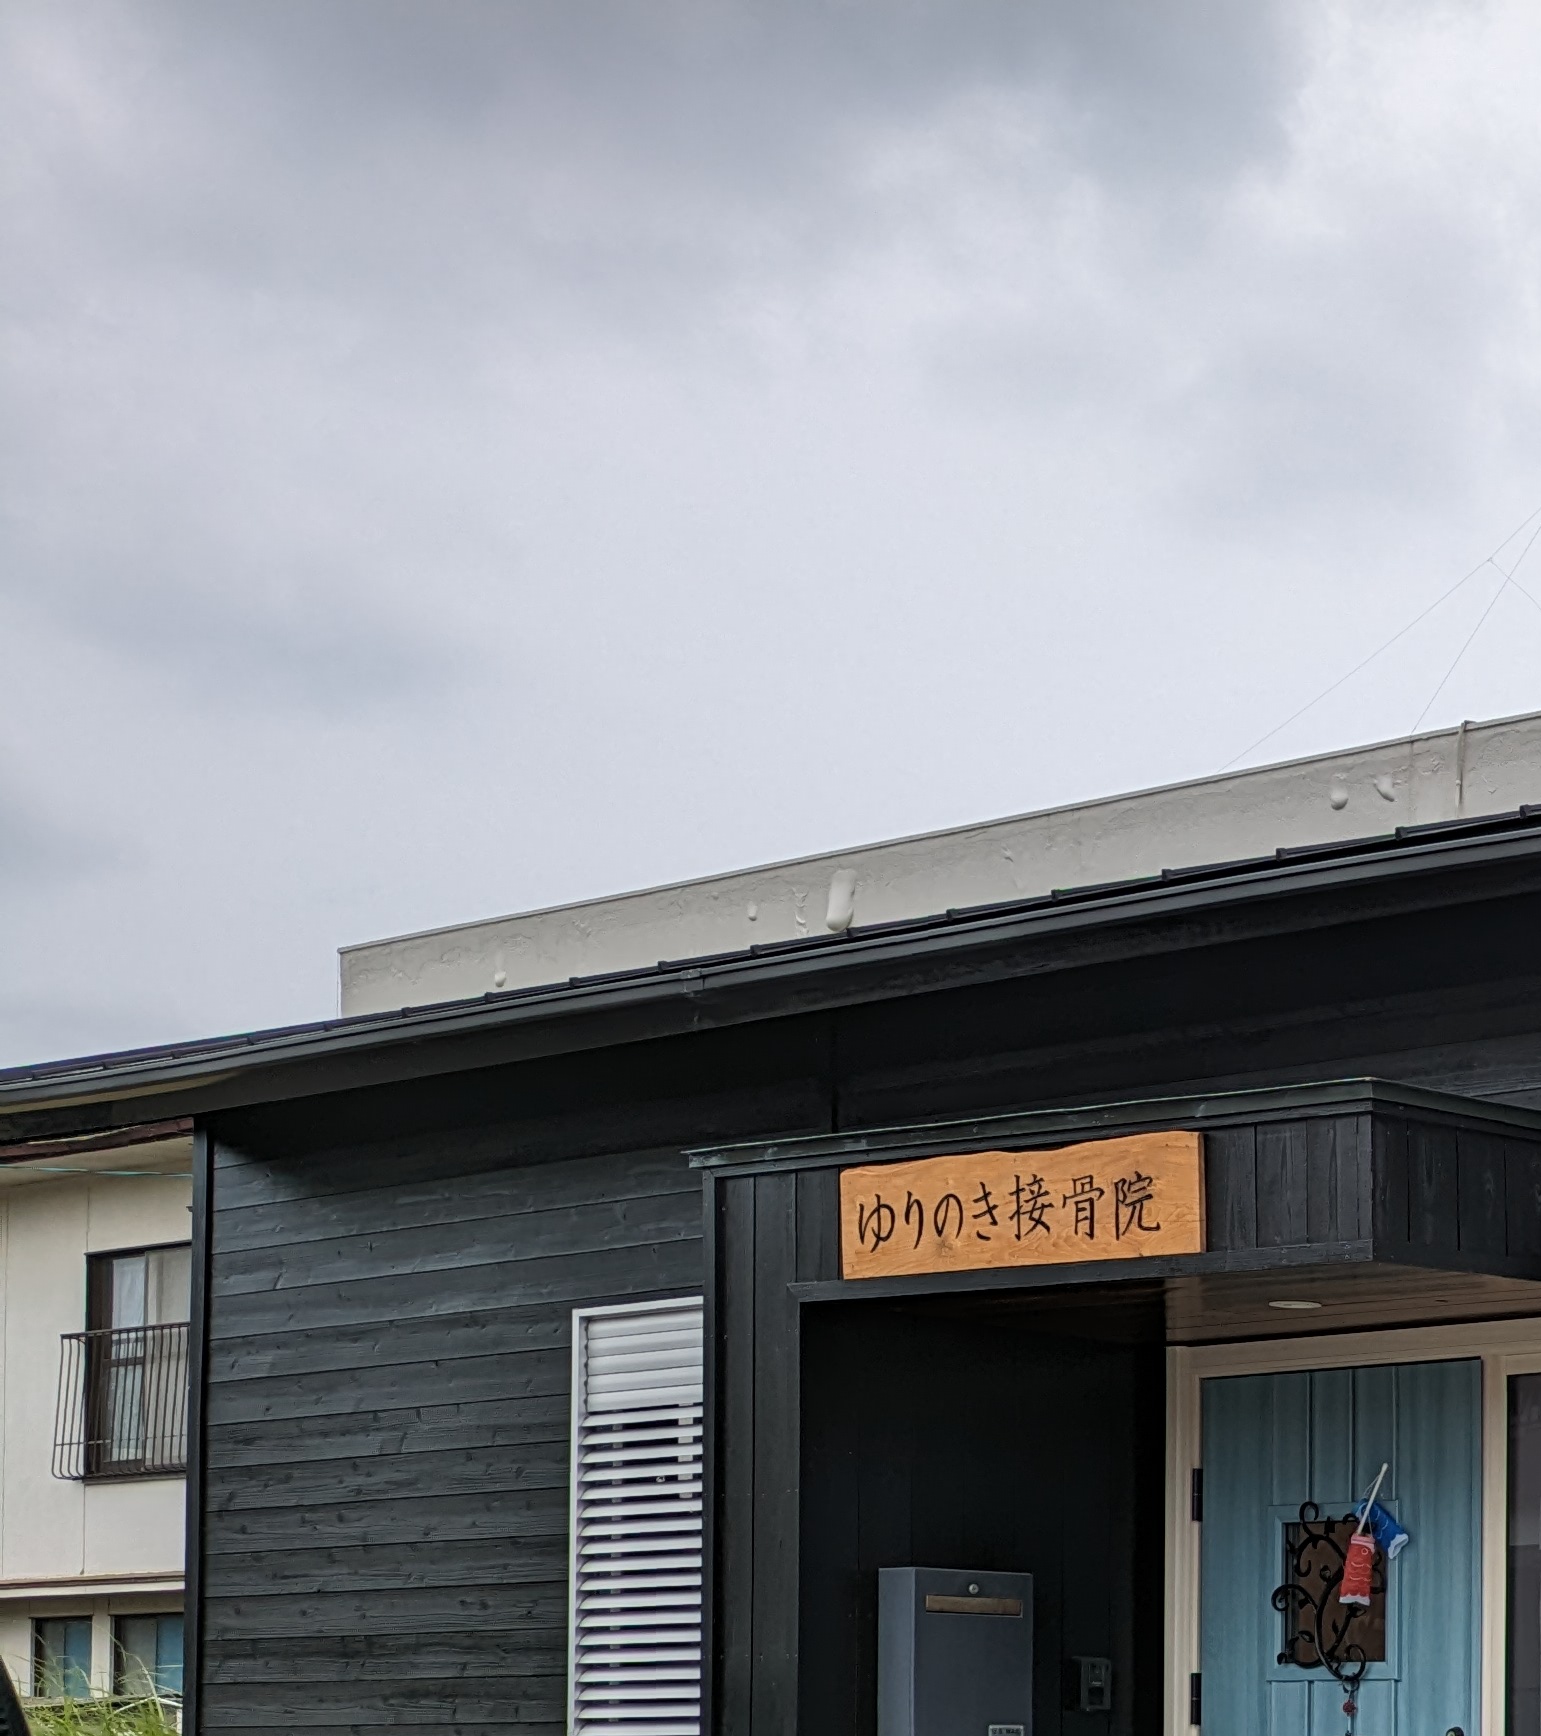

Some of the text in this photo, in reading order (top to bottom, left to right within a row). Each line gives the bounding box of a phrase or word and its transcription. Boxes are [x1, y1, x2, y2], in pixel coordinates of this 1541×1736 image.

[857, 1170, 1163, 1254] ゆりのき接骨院
